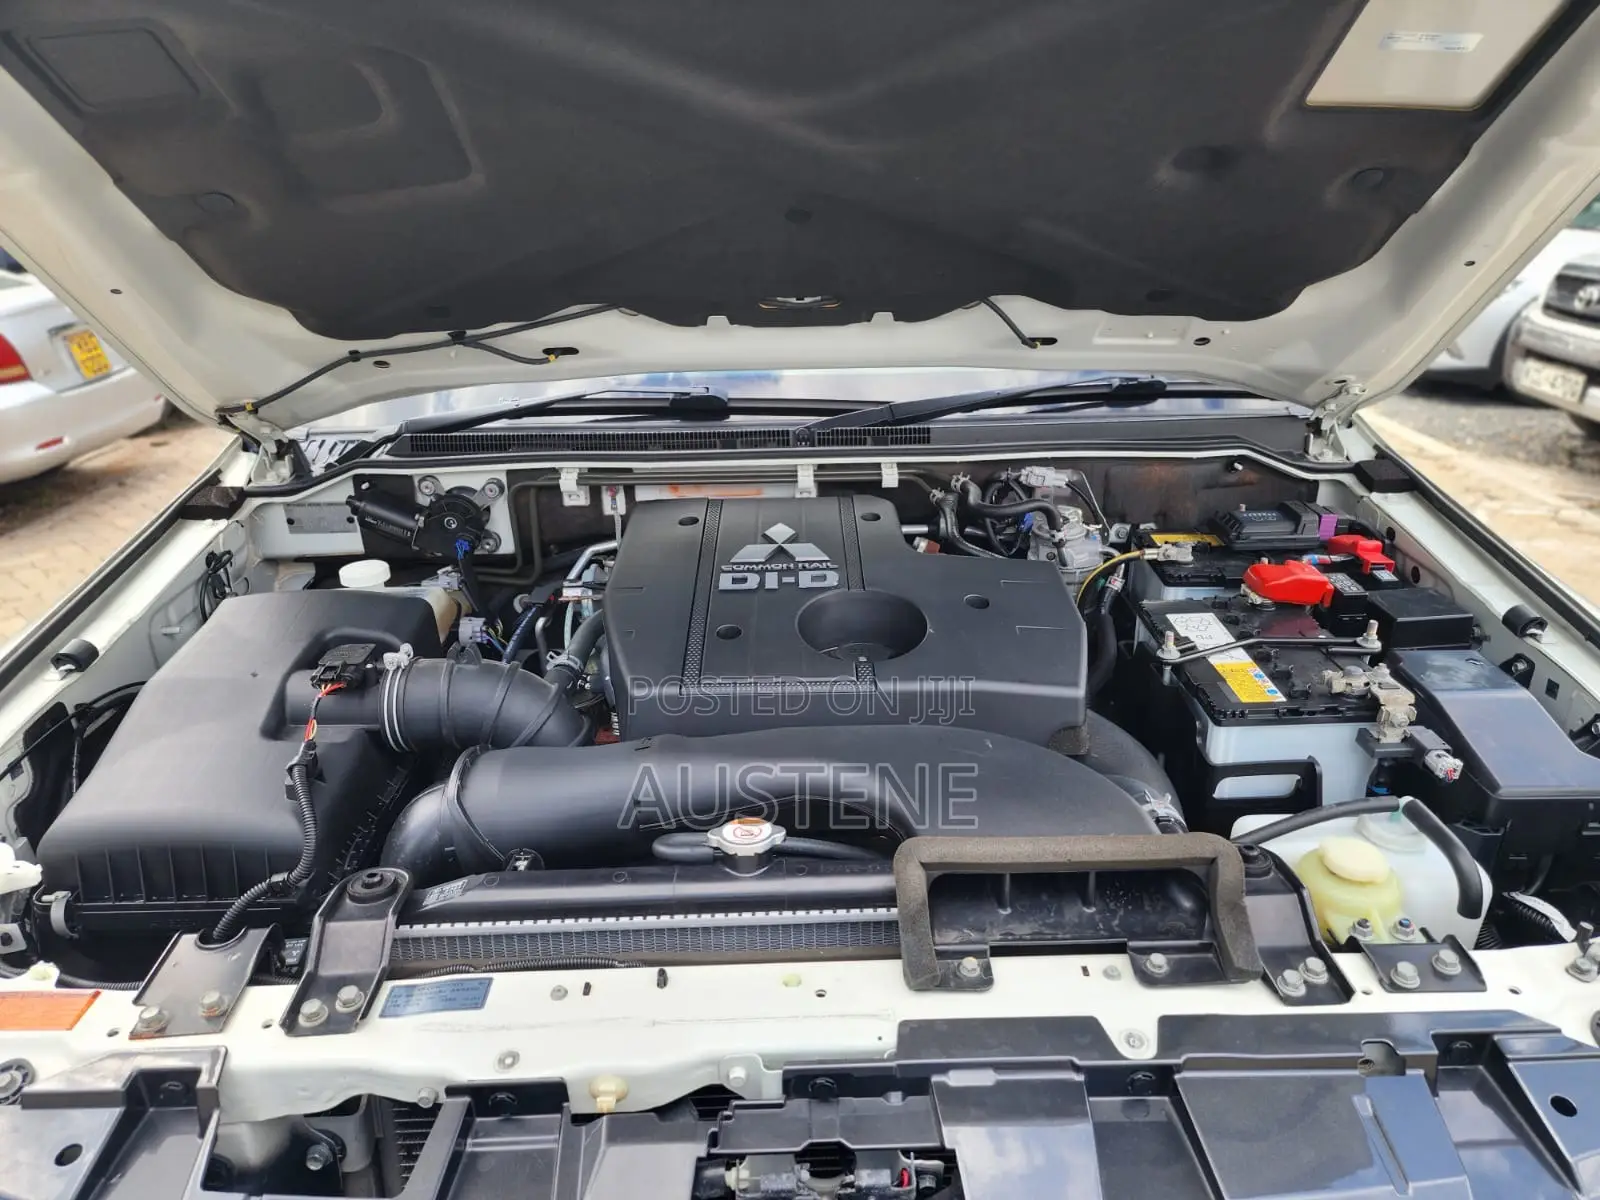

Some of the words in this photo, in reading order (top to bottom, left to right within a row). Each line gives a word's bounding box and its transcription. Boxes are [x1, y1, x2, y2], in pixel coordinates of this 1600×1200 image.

[720, 562, 794, 571] COMMON
[798, 561, 839, 570] RAIL
[718, 570, 840, 591] DI-D
